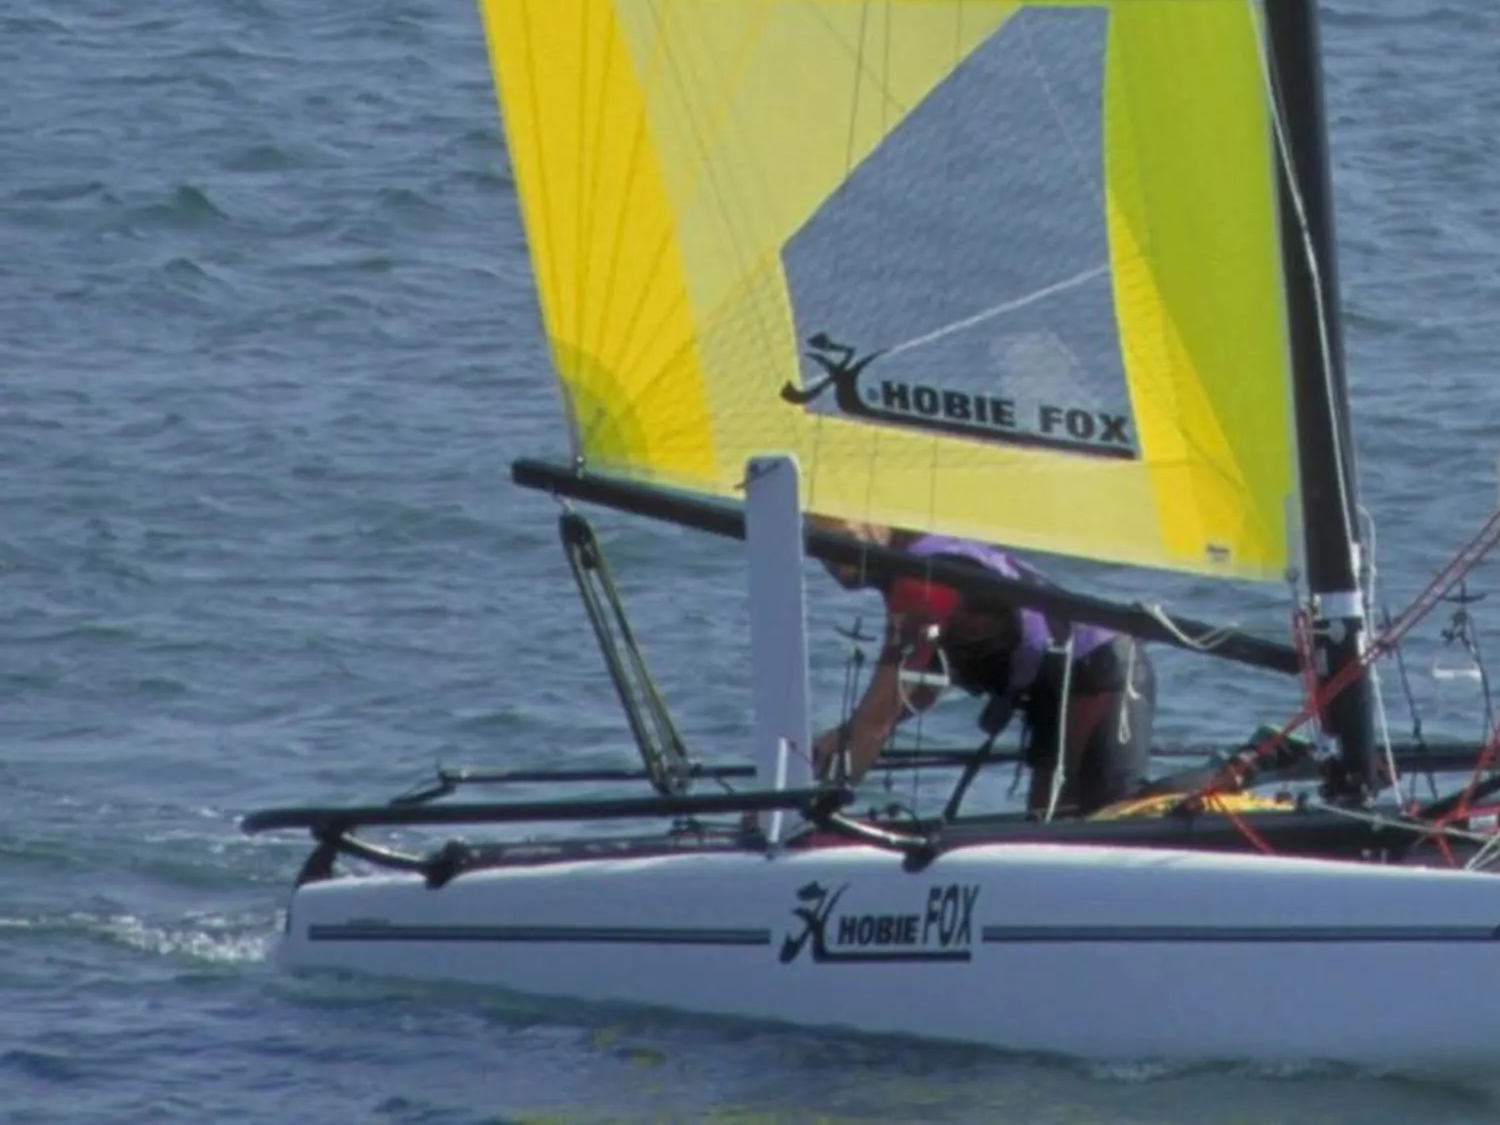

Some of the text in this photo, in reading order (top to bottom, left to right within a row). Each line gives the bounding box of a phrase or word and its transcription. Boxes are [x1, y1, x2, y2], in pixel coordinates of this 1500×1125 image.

[880, 379, 1129, 444] HOBIE FOX
[837, 884, 981, 947] HOBIE FOX
